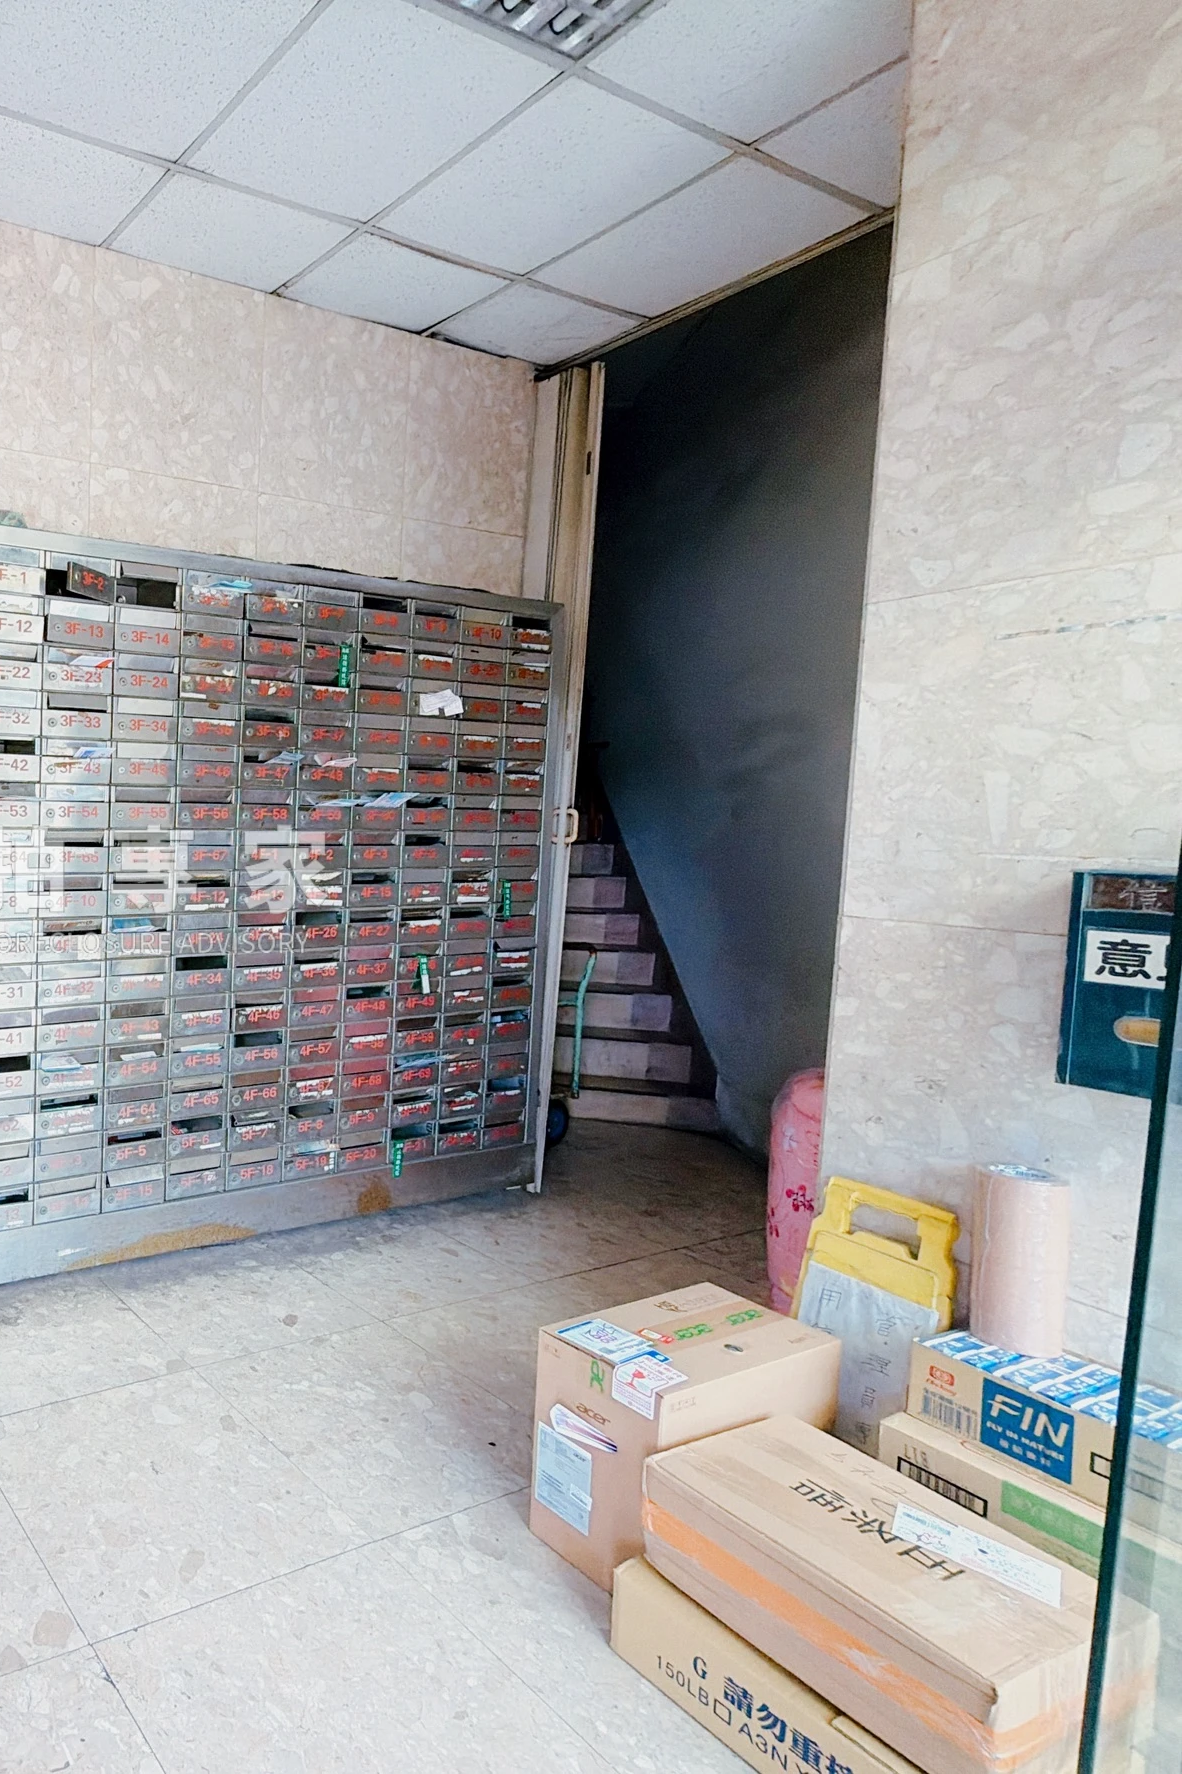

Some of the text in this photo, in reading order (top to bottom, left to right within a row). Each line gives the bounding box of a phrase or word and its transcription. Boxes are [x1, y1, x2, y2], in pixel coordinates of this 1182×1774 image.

[82, 570, 105, 592] 3F-2
[64, 621, 104, 638] 3F-13
[131, 630, 170, 645] 3F-14
[61, 669, 103, 683] 3F-23
[130, 675, 168, 688] 3F-24
[60, 715, 101, 729] 3F-33
[129, 719, 167, 733] 3F-34
[59, 762, 101, 774] 3F-43
[255, 765, 290, 779] 3F-47
[58, 806, 99, 818] 3F-54
[129, 807, 167, 819] 3F-55
[193, 807, 229, 820] 3F-56
[252, 808, 288, 820] 3F-58
[251, 849, 279, 860] 4F-1
[308, 849, 334, 860] 4F-2
[363, 849, 388, 860] 4F-3
[189, 890, 226, 902] 4F-12
[360, 886, 392, 898] 4F-15
[56, 894, 97, 908] 4F-10
[306, 927, 338, 939] 4F-26
[359, 926, 391, 937] 4F-27
[1095, 939, 1167, 981] 意
[356, 963, 388, 975] 4F-37
[186, 972, 222, 985] 4F-34
[54, 981, 94, 996] 4F-32
[354, 1000, 386, 1012] 4F-48
[405, 996, 435, 1009] 4F-49
[247, 1011, 280, 1023] 4F-46
[302, 1005, 334, 1017] 4F-47
[186, 1013, 221, 1027] 4F-45
[120, 1020, 160, 1034] 4F-43
[405, 1032, 435, 1044] 4F-59
[244, 1049, 278, 1061] 4F-56
[300, 1044, 332, 1056] 4F-57
[184, 1055, 221, 1067] 4F-55
[120, 1062, 158, 1075] 4F-54
[402, 1068, 432, 1081] 4F-69
[351, 1075, 383, 1088] 4F-68
[243, 1087, 277, 1101] 4F-66
[183, 1096, 219, 1108] 4F-65
[119, 1103, 156, 1118] 4F-64
[298, 1120, 324, 1132] 5F-8
[349, 1114, 375, 1125] 5F-9
[241, 1129, 268, 1141] 5F-7
[181, 1136, 209, 1148] 5F-6
[115, 1144, 147, 1160] 5F-5
[346, 1149, 376, 1162] 5F-20
[240, 1166, 274, 1180] 5F-18
[576, 1403, 611, 1426] acer
[988, 1394, 1070, 1448] FIN
[693, 1656, 708, 1680] G
[656, 1655, 710, 1707] 150LB
